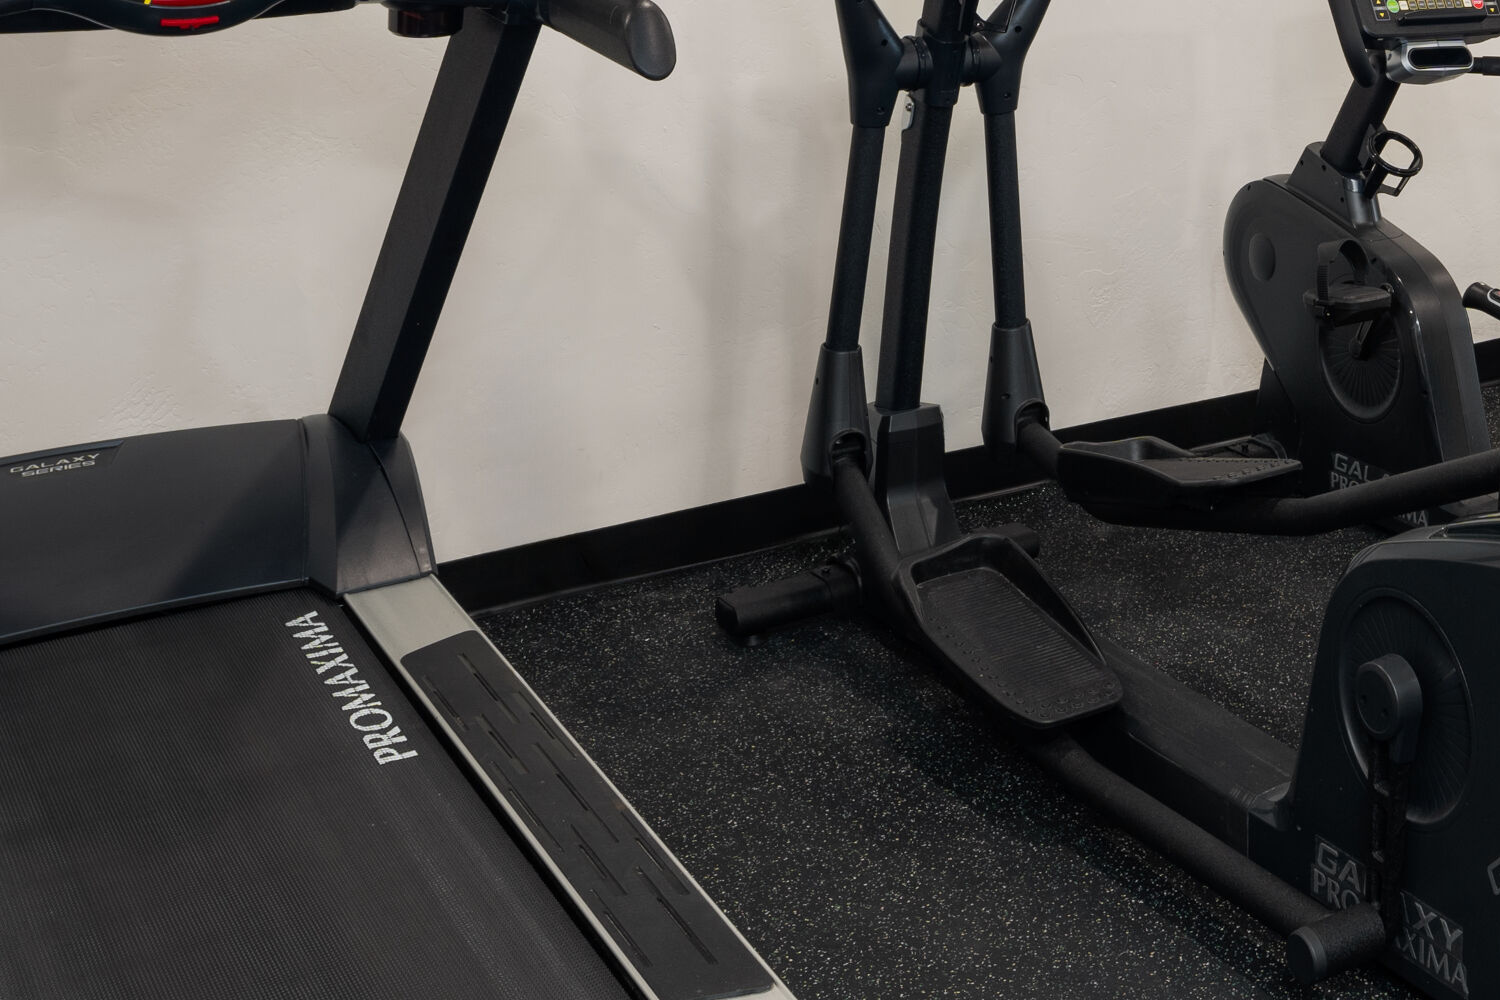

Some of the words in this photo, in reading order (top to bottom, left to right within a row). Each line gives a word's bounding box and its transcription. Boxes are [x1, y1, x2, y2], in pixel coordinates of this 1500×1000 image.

[10, 453, 100, 473] GALAXY
[21, 460, 96, 477] SERIES
[285, 610, 418, 765] PROMAXIMA
